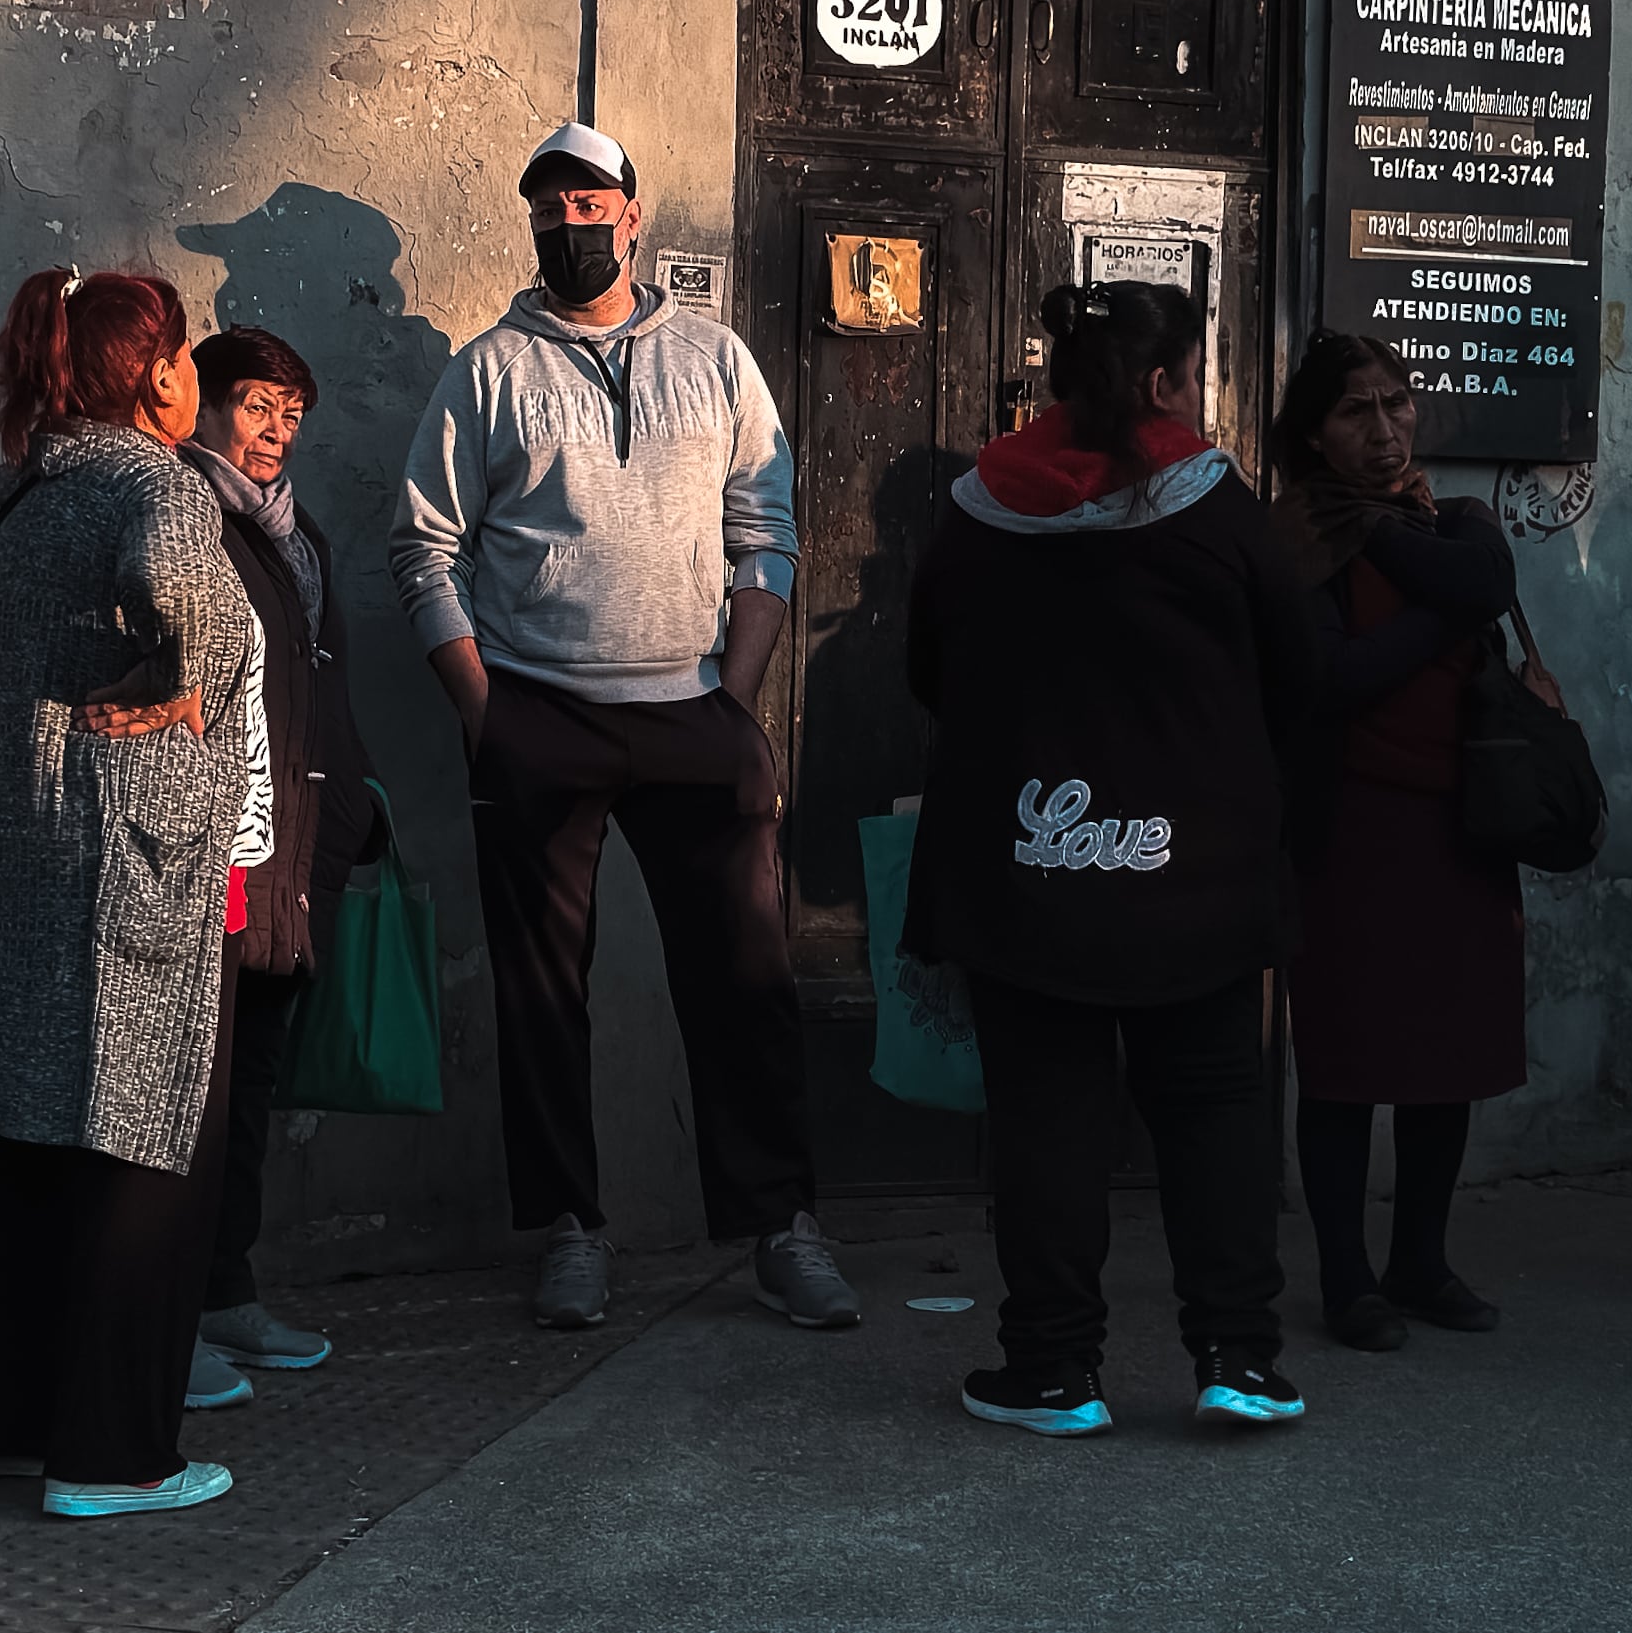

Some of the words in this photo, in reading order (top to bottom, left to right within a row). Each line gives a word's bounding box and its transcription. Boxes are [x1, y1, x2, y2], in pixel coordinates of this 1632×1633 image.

[843, 27, 920, 58] INCLAN
[1379, 28, 1467, 58] Artesania
[1473, 40, 1494, 60] en
[1500, 37, 1565, 66] Madera
[1348, 76, 1435, 111] Revestimientos
[1443, 83, 1530, 117] Amoblamientos
[1532, 95, 1546, 118] en
[1548, 90, 1593, 120] General
[1354, 124, 1423, 148] INCLAN
[1428, 128, 1493, 153] 3206/10
[1510, 133, 1549, 160] Cap.
[1553, 135, 1590, 159] Fed.
[1451, 161, 1555, 187] 4912-3744
[1368, 212, 1570, 247] naval_oscar@hotmail.com
[1411, 269, 1533, 294] SEGUIMOS
[1372, 298, 1522, 325] ATENDIENDO
[1530, 306, 1567, 328] EN:
[1462, 341, 1518, 364] Diaz
[1527, 344, 1575, 367] 464
[1408, 370, 1518, 397] C.A.B.A.
[1014, 779, 1171, 870] Love
